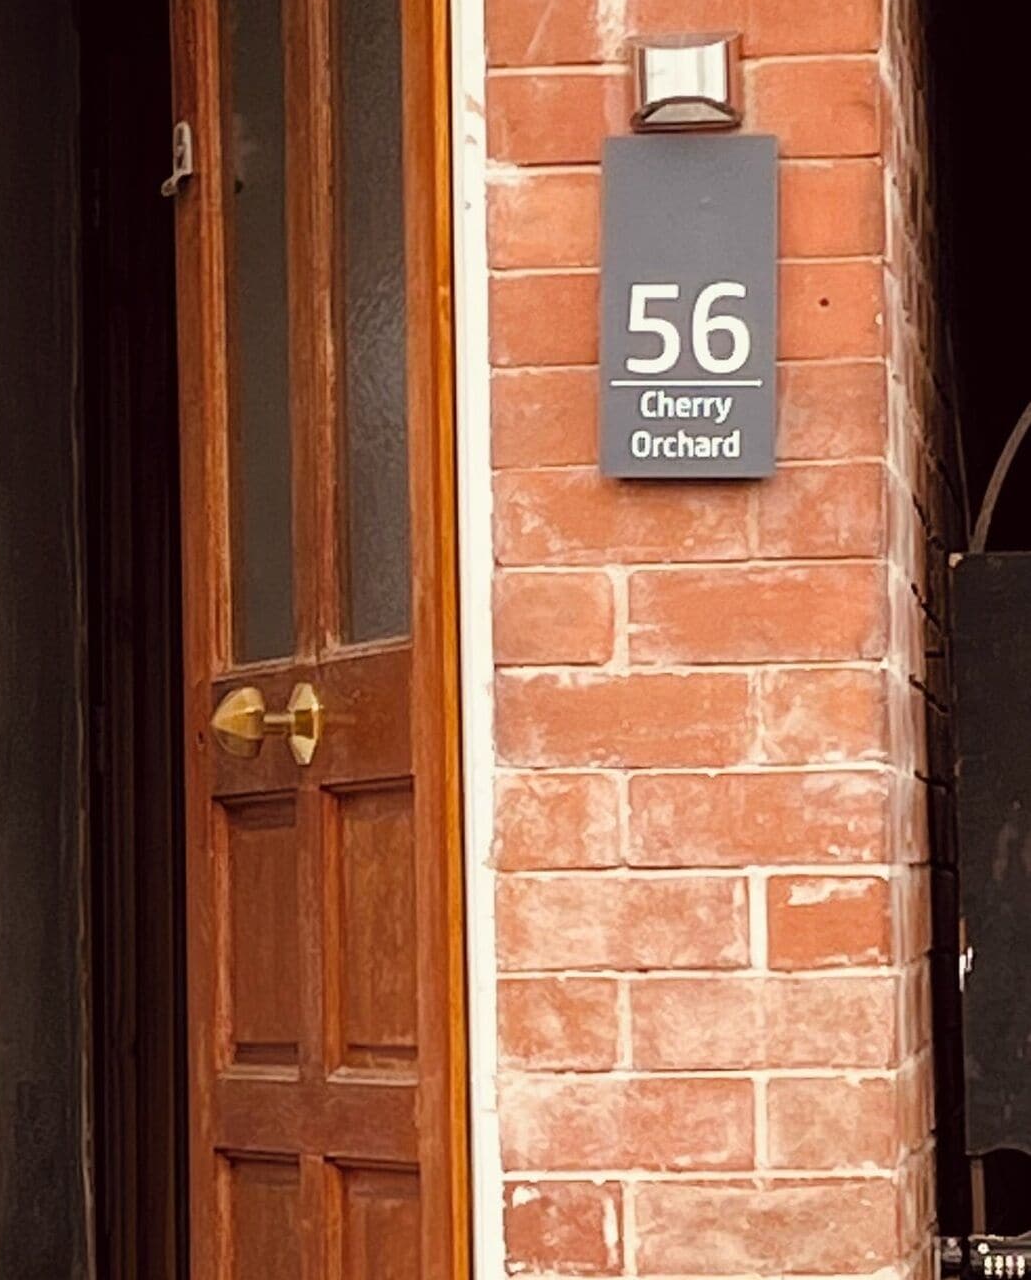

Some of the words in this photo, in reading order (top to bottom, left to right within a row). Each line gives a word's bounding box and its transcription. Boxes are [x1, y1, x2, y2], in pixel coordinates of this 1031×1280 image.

[626, 281, 751, 375] 56
[640, 389, 733, 424] Cherry
[631, 429, 741, 459] Orchard
